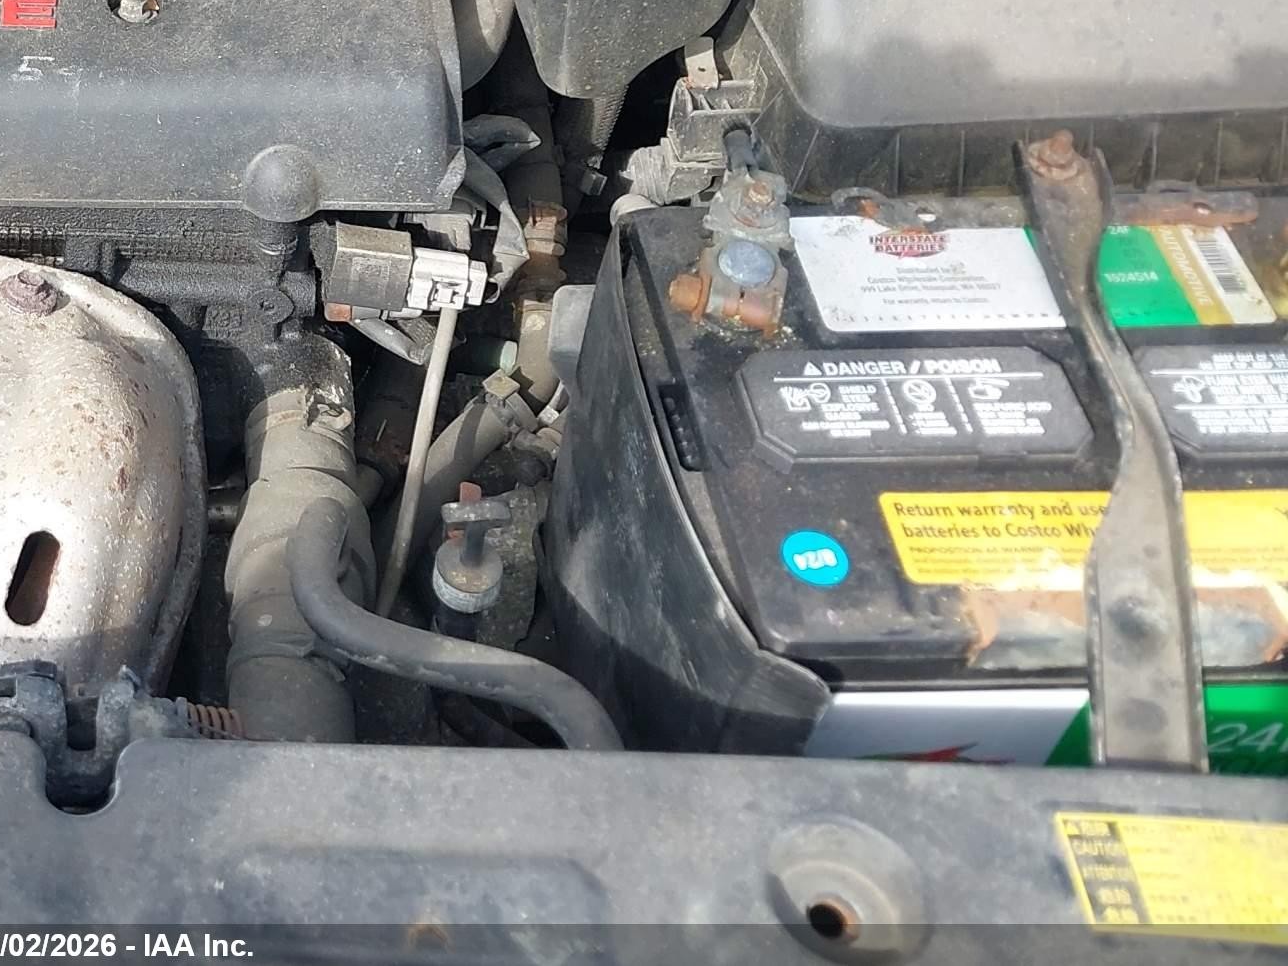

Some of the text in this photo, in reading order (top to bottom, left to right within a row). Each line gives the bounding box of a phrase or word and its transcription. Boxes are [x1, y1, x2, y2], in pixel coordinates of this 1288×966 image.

[868, 234, 949, 244] INTERSTATE
[874, 244, 946, 253] BATTERIES
[822, 358, 1003, 376] DANGER / POISON
[838, 385, 877, 394] SHIELD
[820, 403, 881, 412] EXPLOSIVE
[894, 503, 954, 517] Return
[956, 503, 1035, 519] warranty
[1041, 502, 1073, 516] and
[902, 523, 979, 538] batteries
[982, 524, 1001, 537] to
[1004, 522, 1062, 538] Costco
